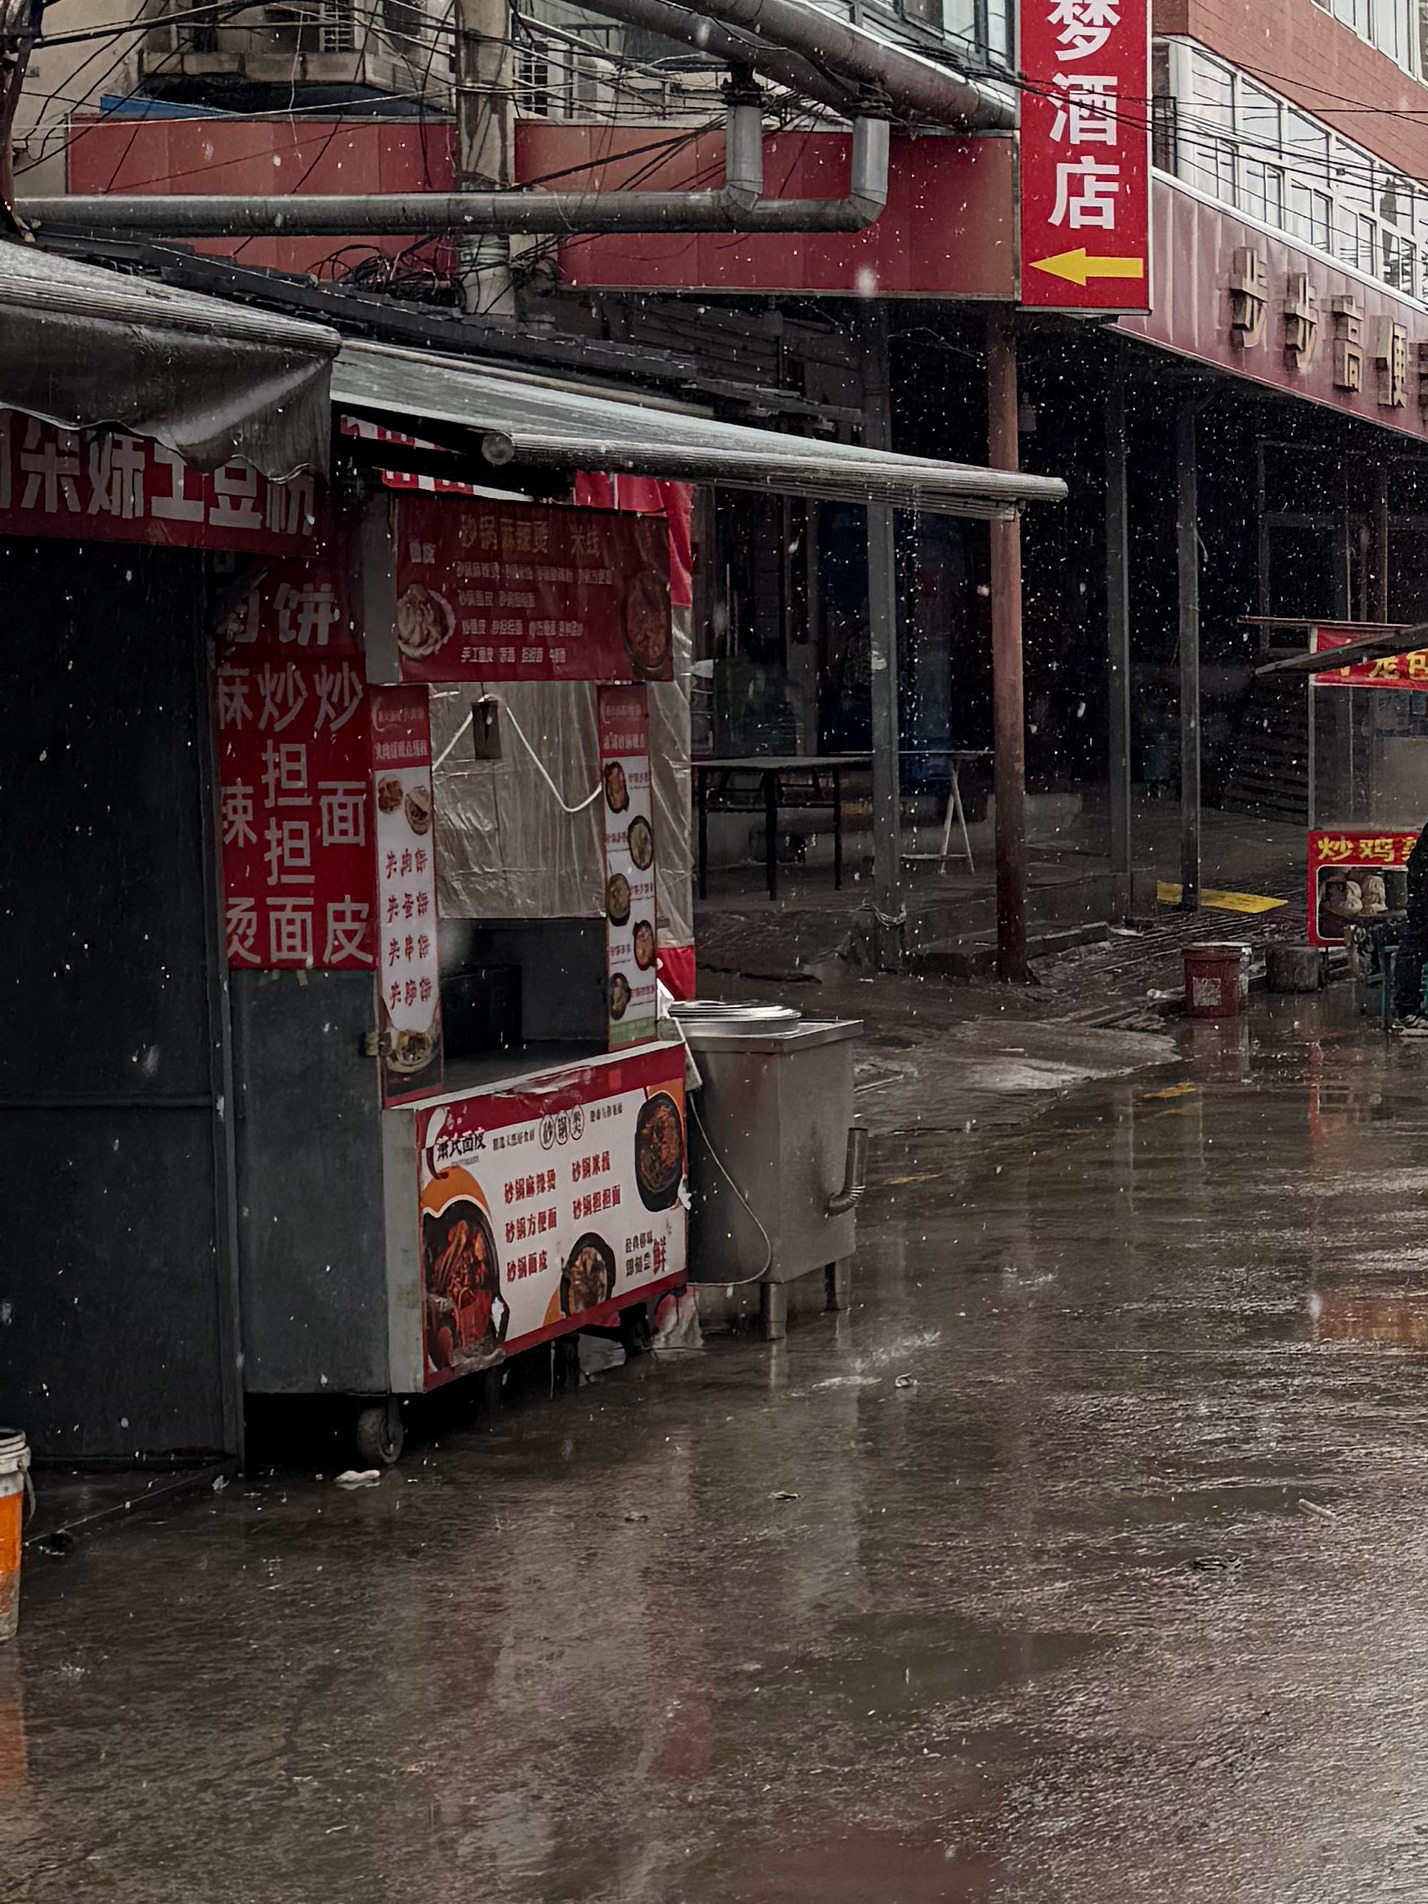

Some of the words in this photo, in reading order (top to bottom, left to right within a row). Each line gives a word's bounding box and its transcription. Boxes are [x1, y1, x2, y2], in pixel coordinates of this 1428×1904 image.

[257, 661, 315, 964] 炒担担面
[313, 661, 374, 964] 炒面皮
[504, 1168, 557, 1205] 砂锅麻辣烫
[572, 1184, 622, 1221] 砂锅担担面
[504, 1207, 557, 1244] 砂锅方便面
[506, 1249, 548, 1284] 砂锅面皮
